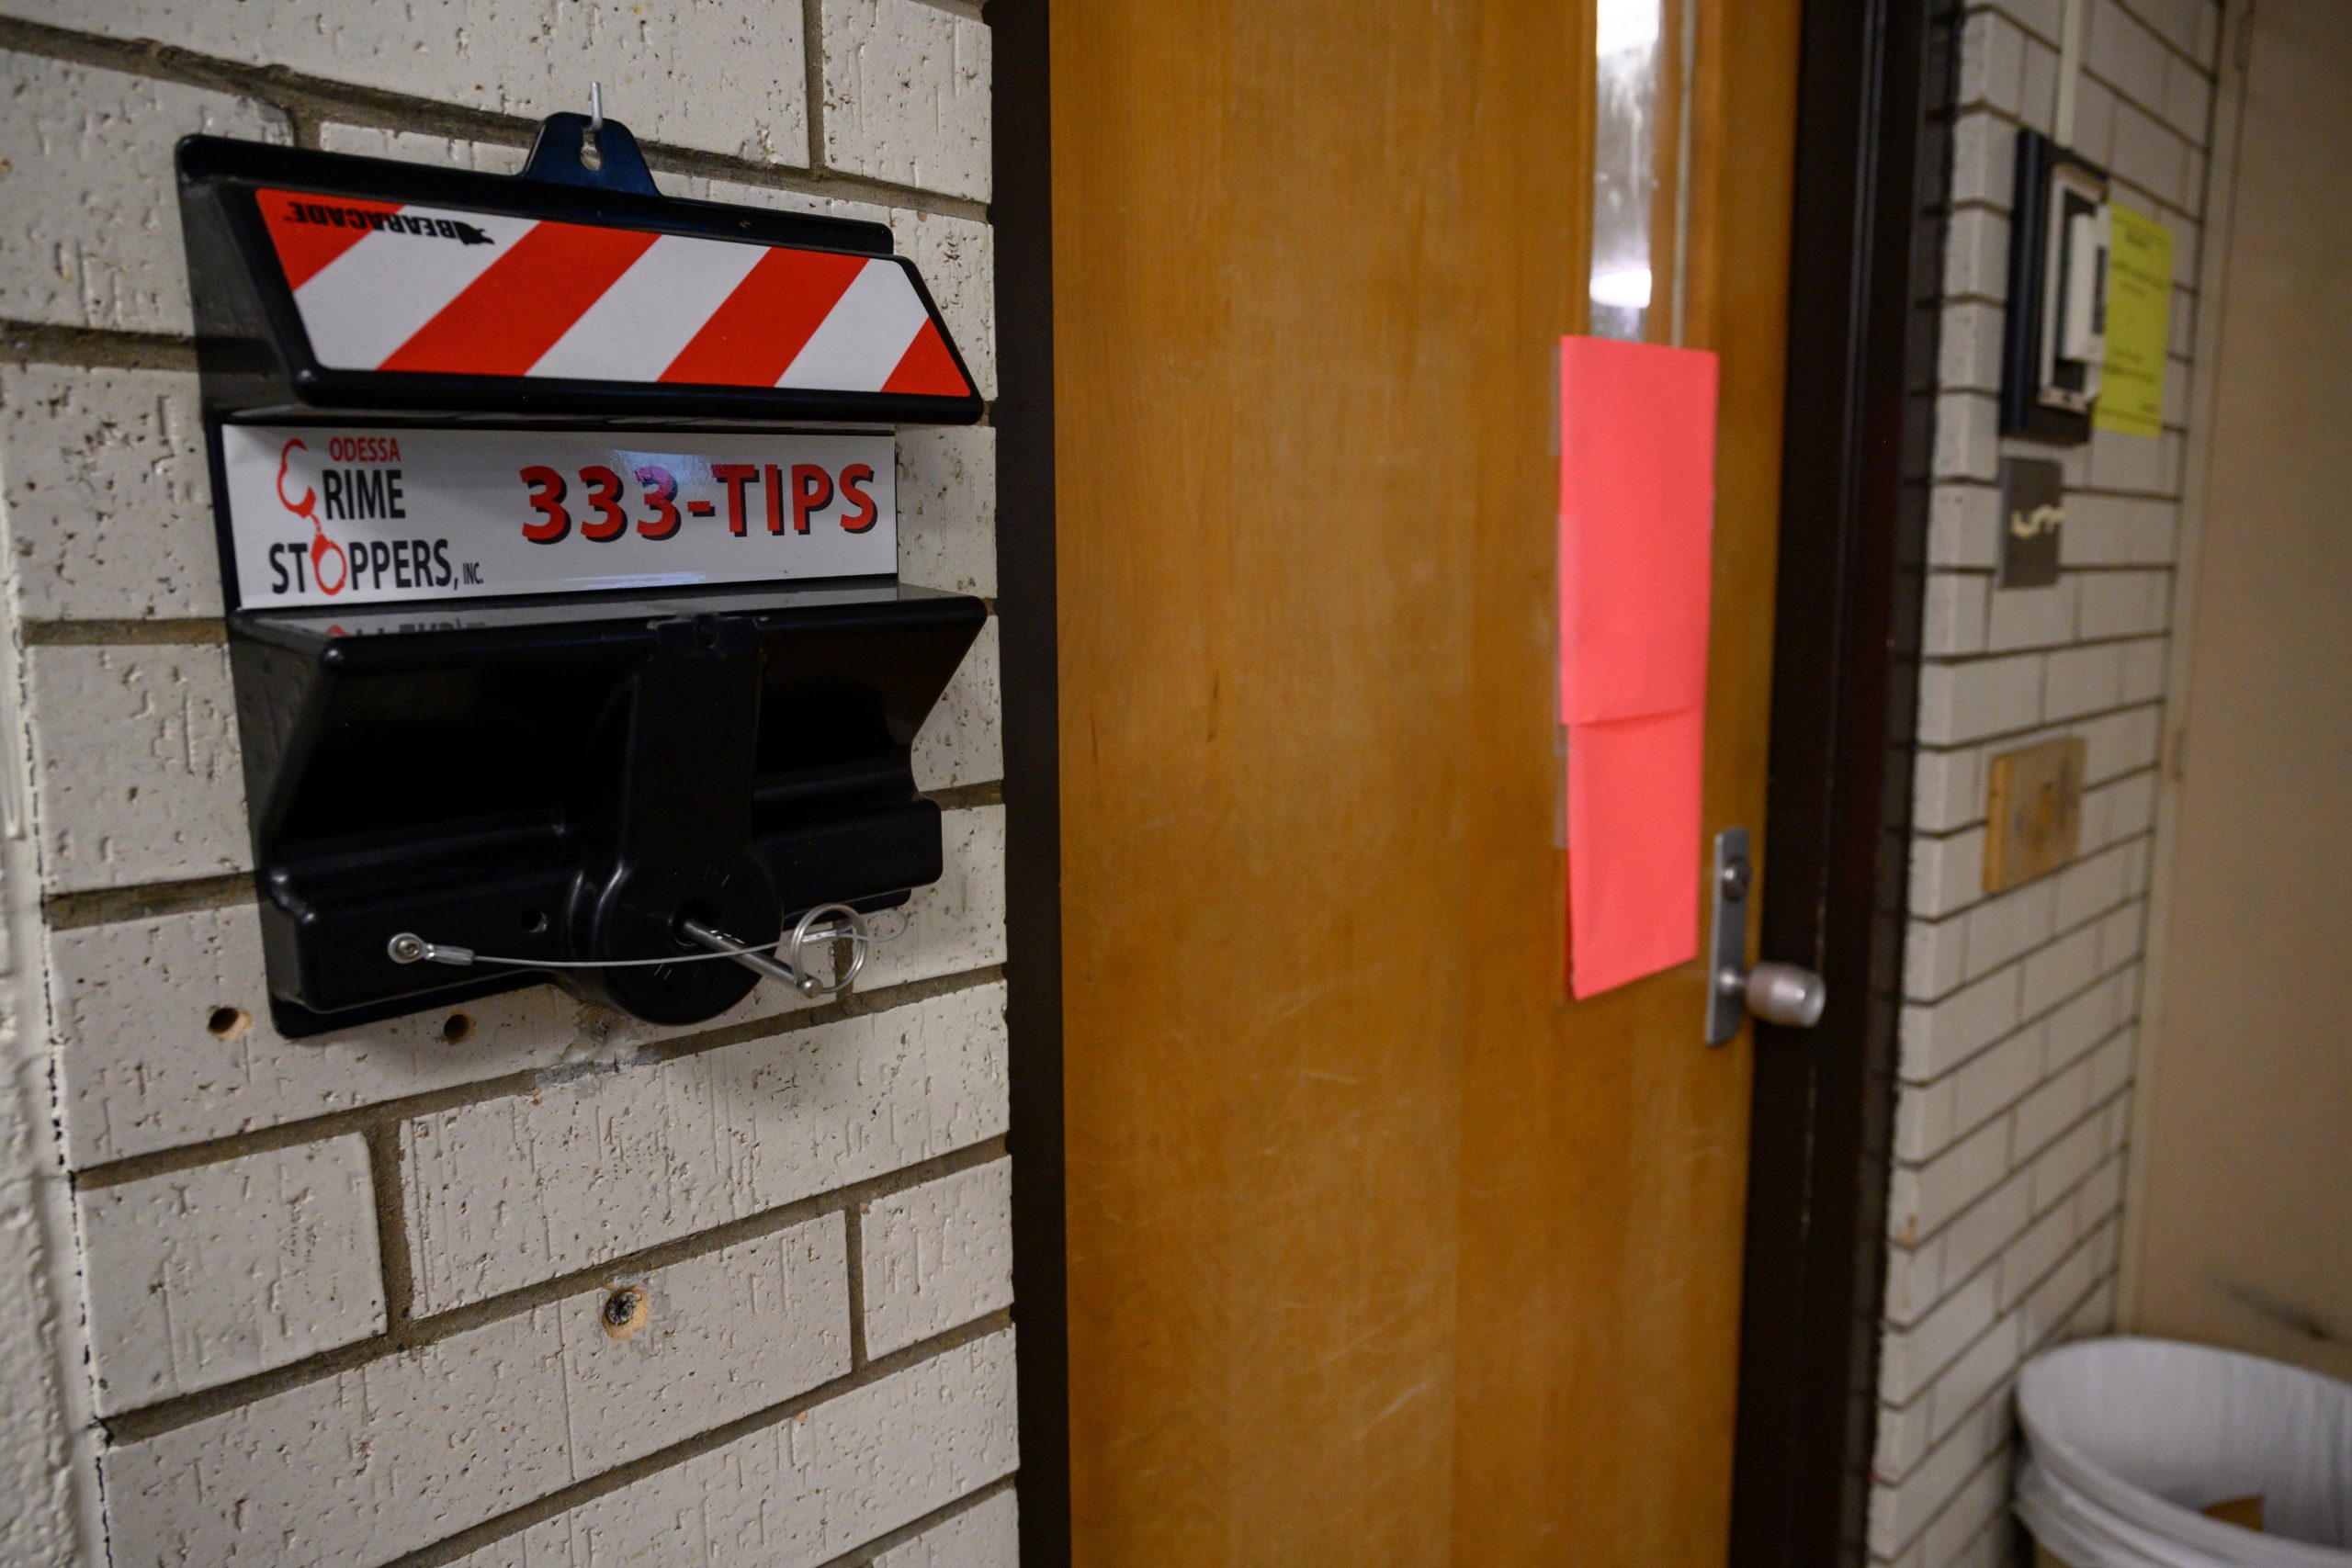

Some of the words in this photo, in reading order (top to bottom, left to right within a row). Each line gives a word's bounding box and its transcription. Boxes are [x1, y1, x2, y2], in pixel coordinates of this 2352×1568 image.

[288, 201, 461, 239] BEARACADE
[329, 436, 401, 462] ODESSA
[518, 463, 878, 545] 333-TIPS
[462, 561, 484, 586] INC.
